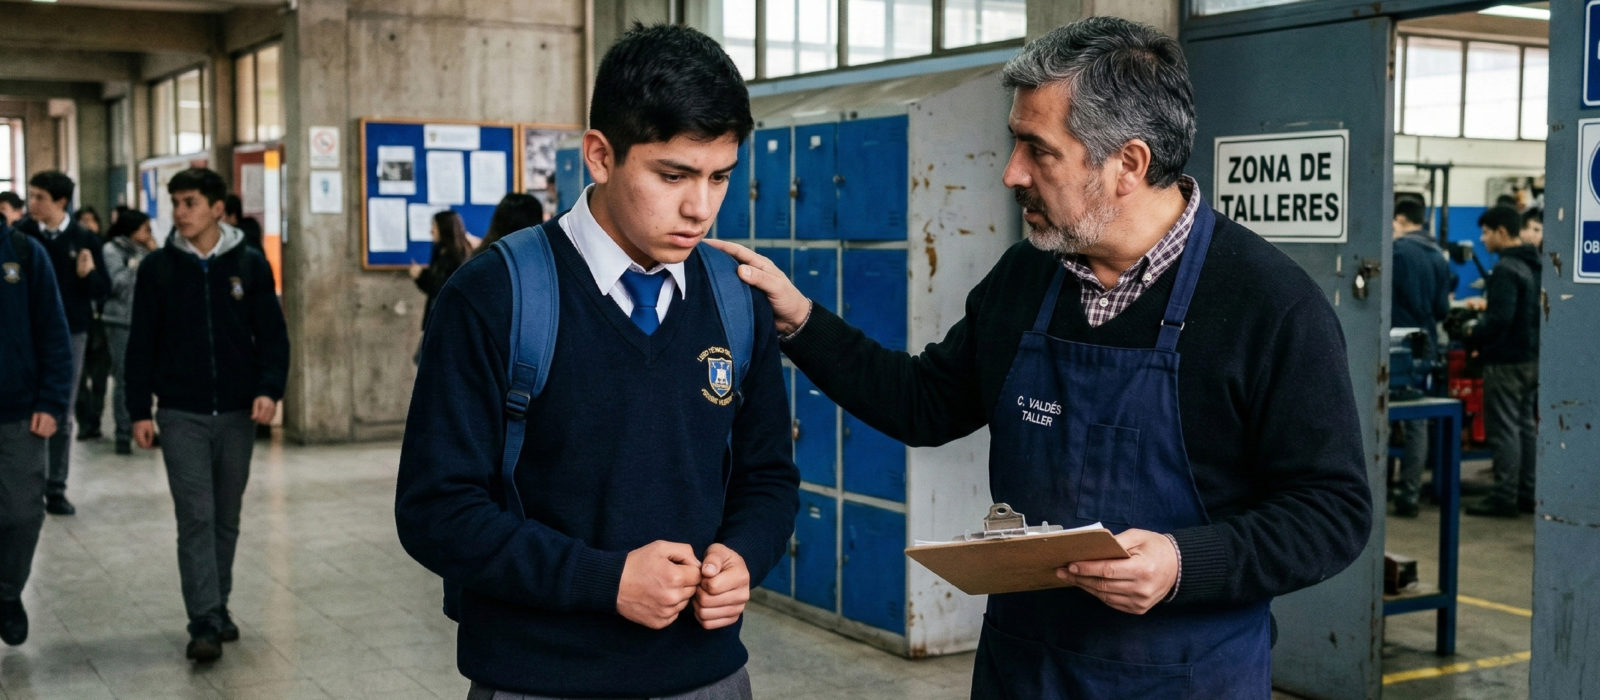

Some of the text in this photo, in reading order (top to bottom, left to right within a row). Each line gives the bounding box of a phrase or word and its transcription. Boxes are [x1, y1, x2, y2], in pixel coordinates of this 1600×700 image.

[1228, 152, 1332, 184] ZONA DE
[1220, 193, 1340, 222] TALLERES
[1017, 395, 1062, 415] C. VALDÉS
[1022, 410, 1053, 427] TALLER
